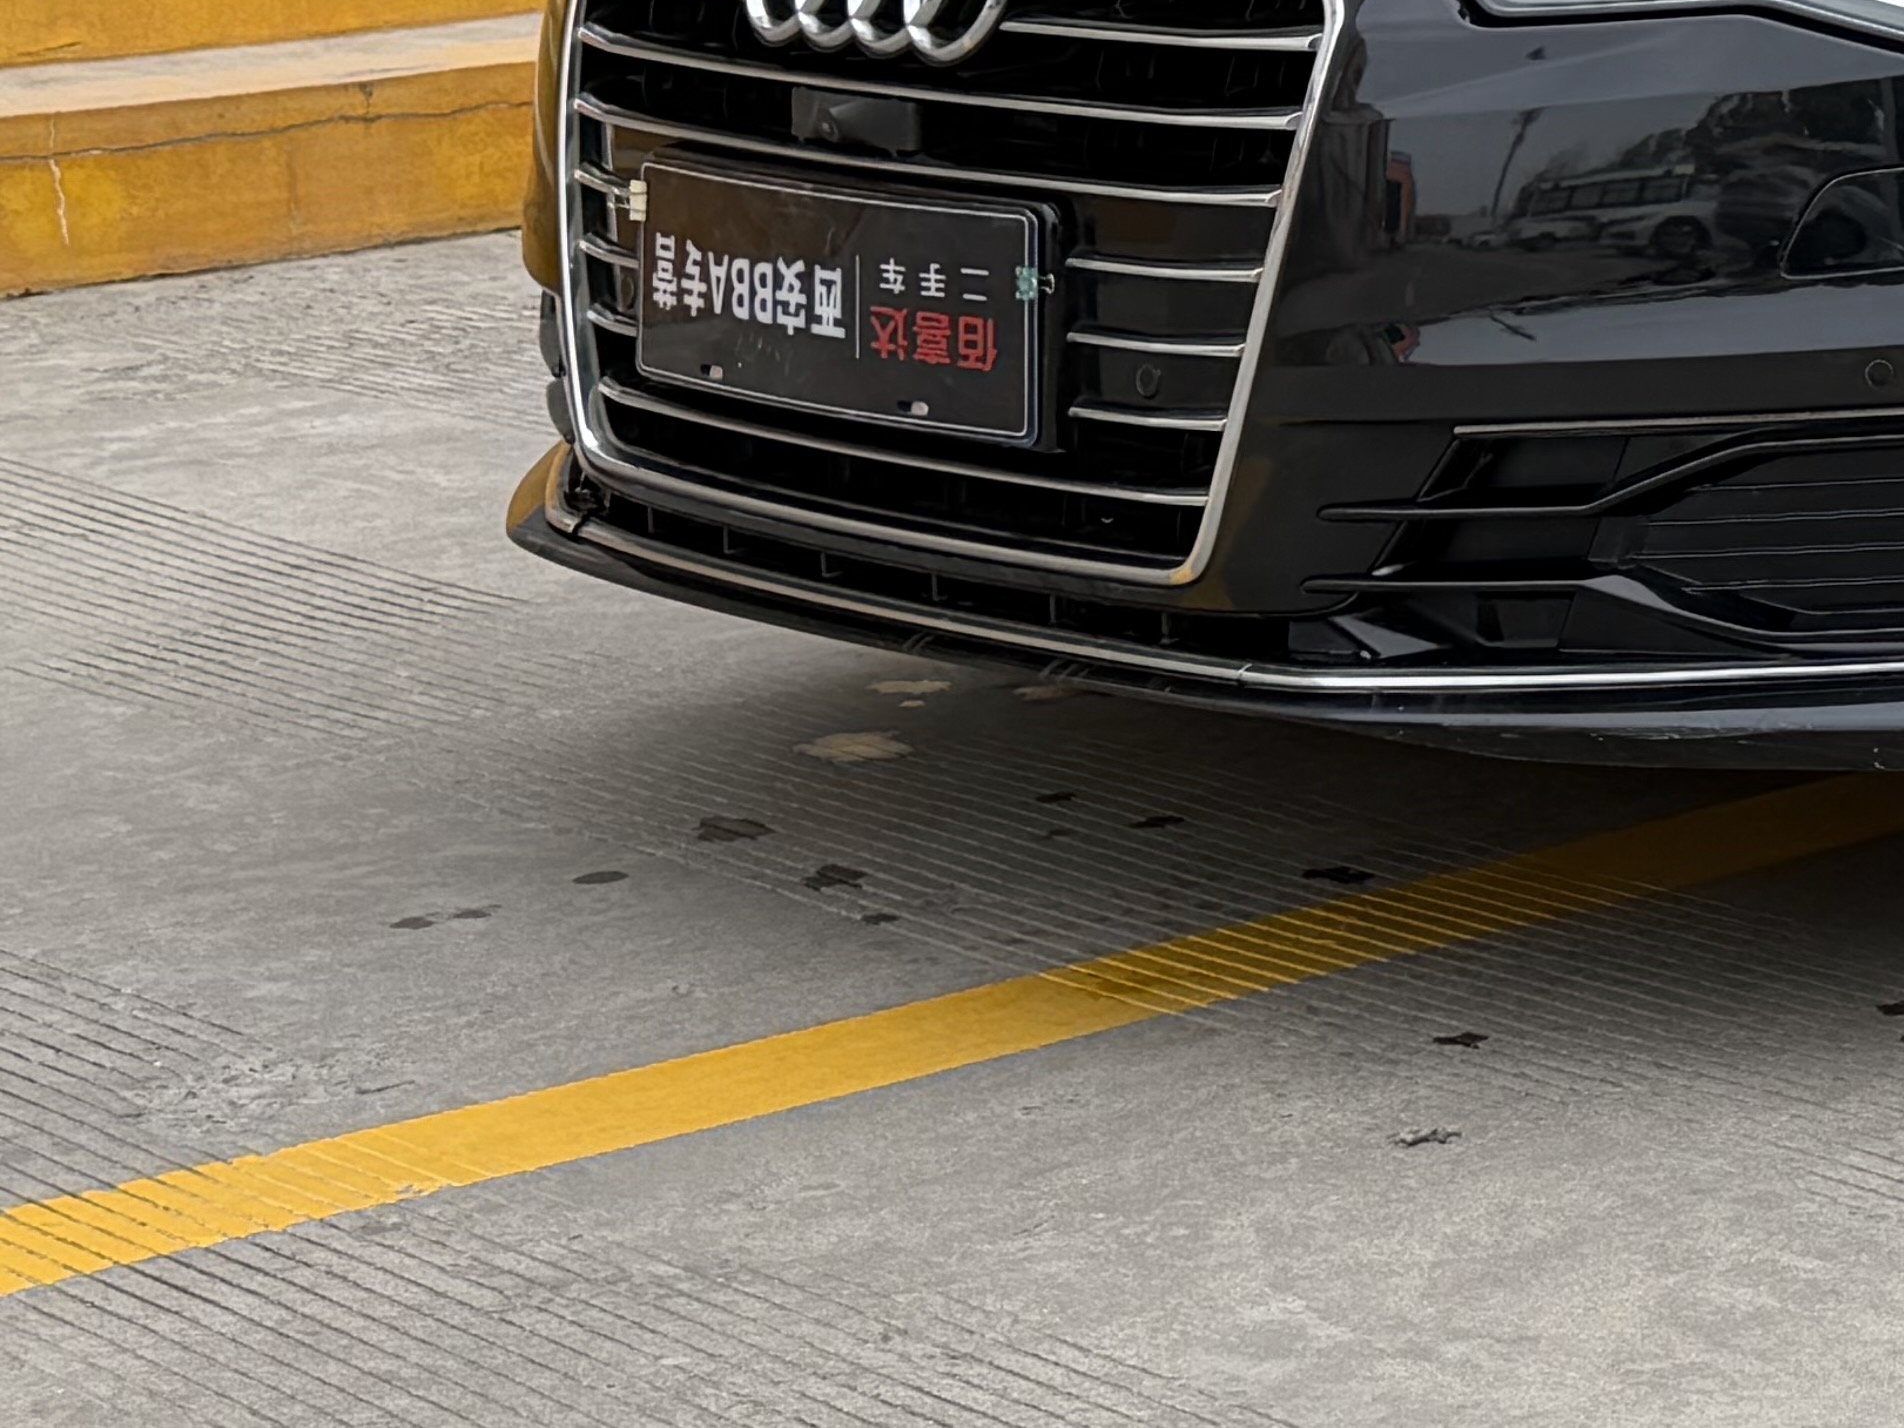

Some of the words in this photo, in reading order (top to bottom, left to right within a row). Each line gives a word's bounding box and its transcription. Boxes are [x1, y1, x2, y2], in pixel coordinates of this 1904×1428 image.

[652, 231, 846, 339] 西安BBA专营
[879, 257, 990, 303] 二手车
[869, 305, 998, 373] 佰喜达
